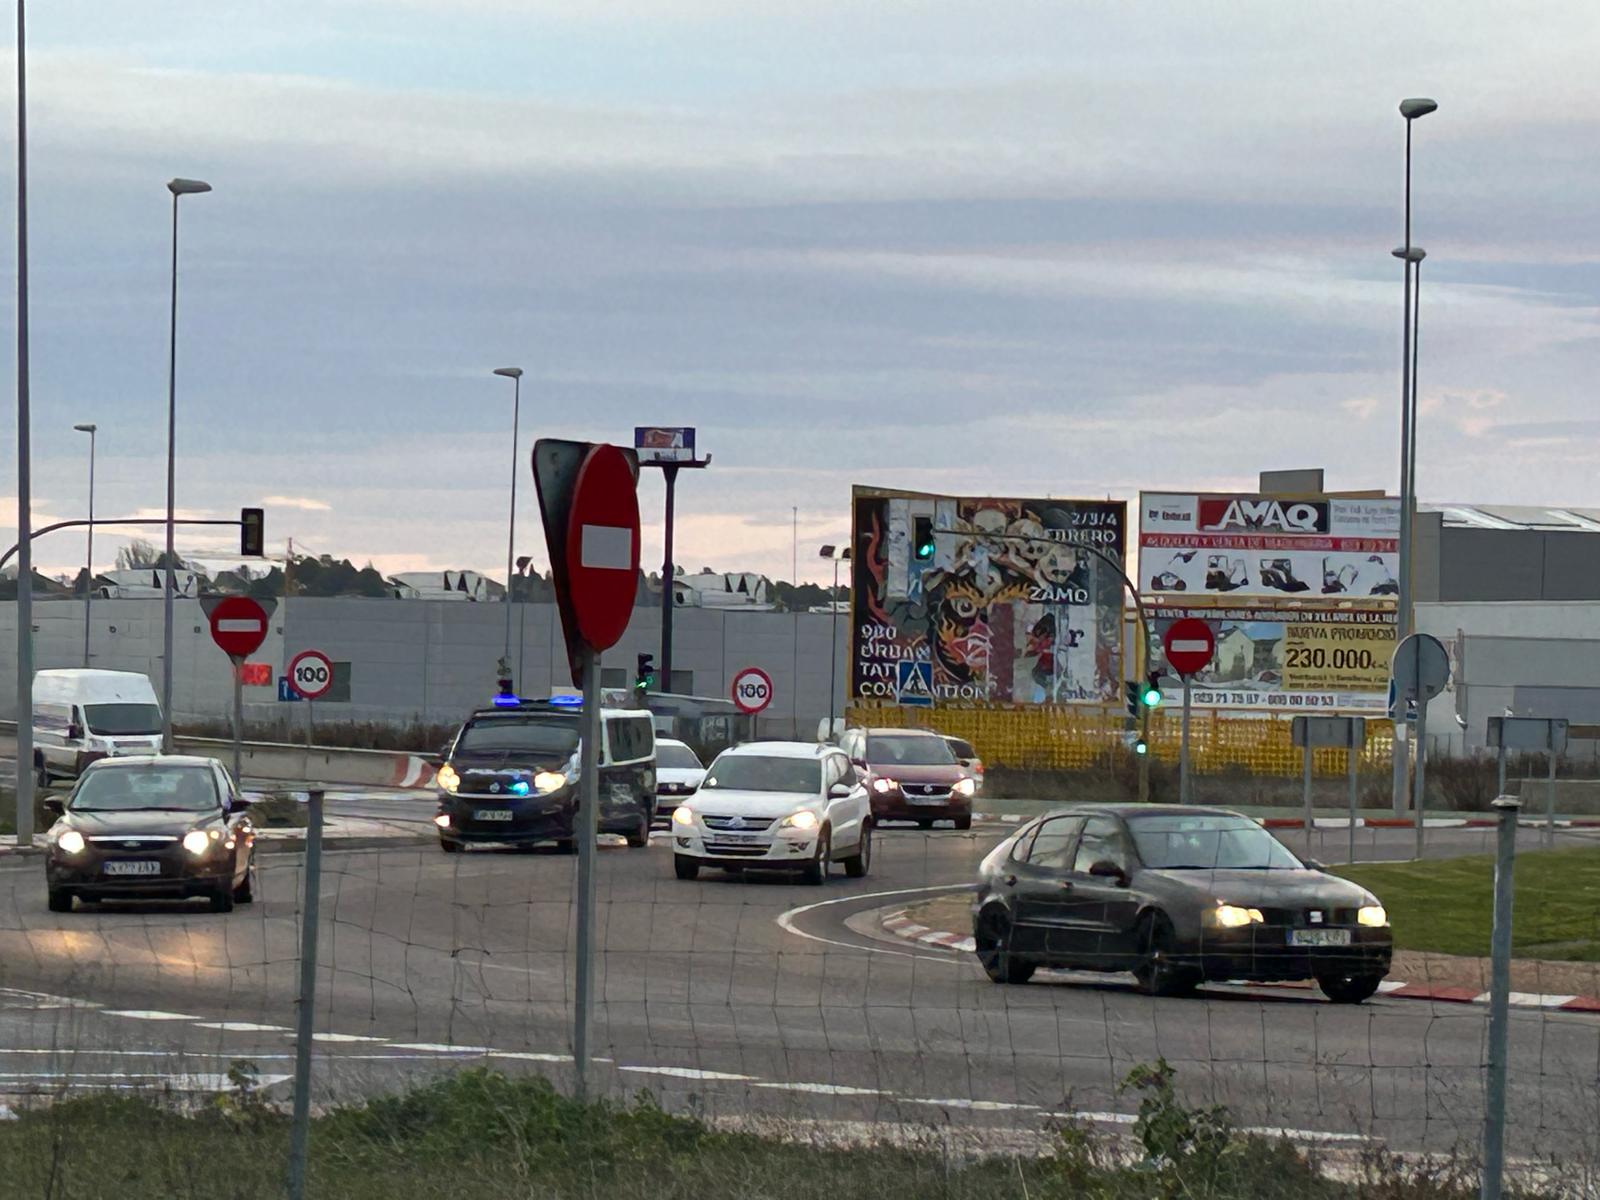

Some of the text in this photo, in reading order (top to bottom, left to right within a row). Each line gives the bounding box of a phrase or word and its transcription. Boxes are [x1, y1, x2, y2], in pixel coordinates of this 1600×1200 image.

[1203, 499, 1319, 533] AMAQ
[296, 667, 328, 683] 100
[739, 684, 767, 699] 100
